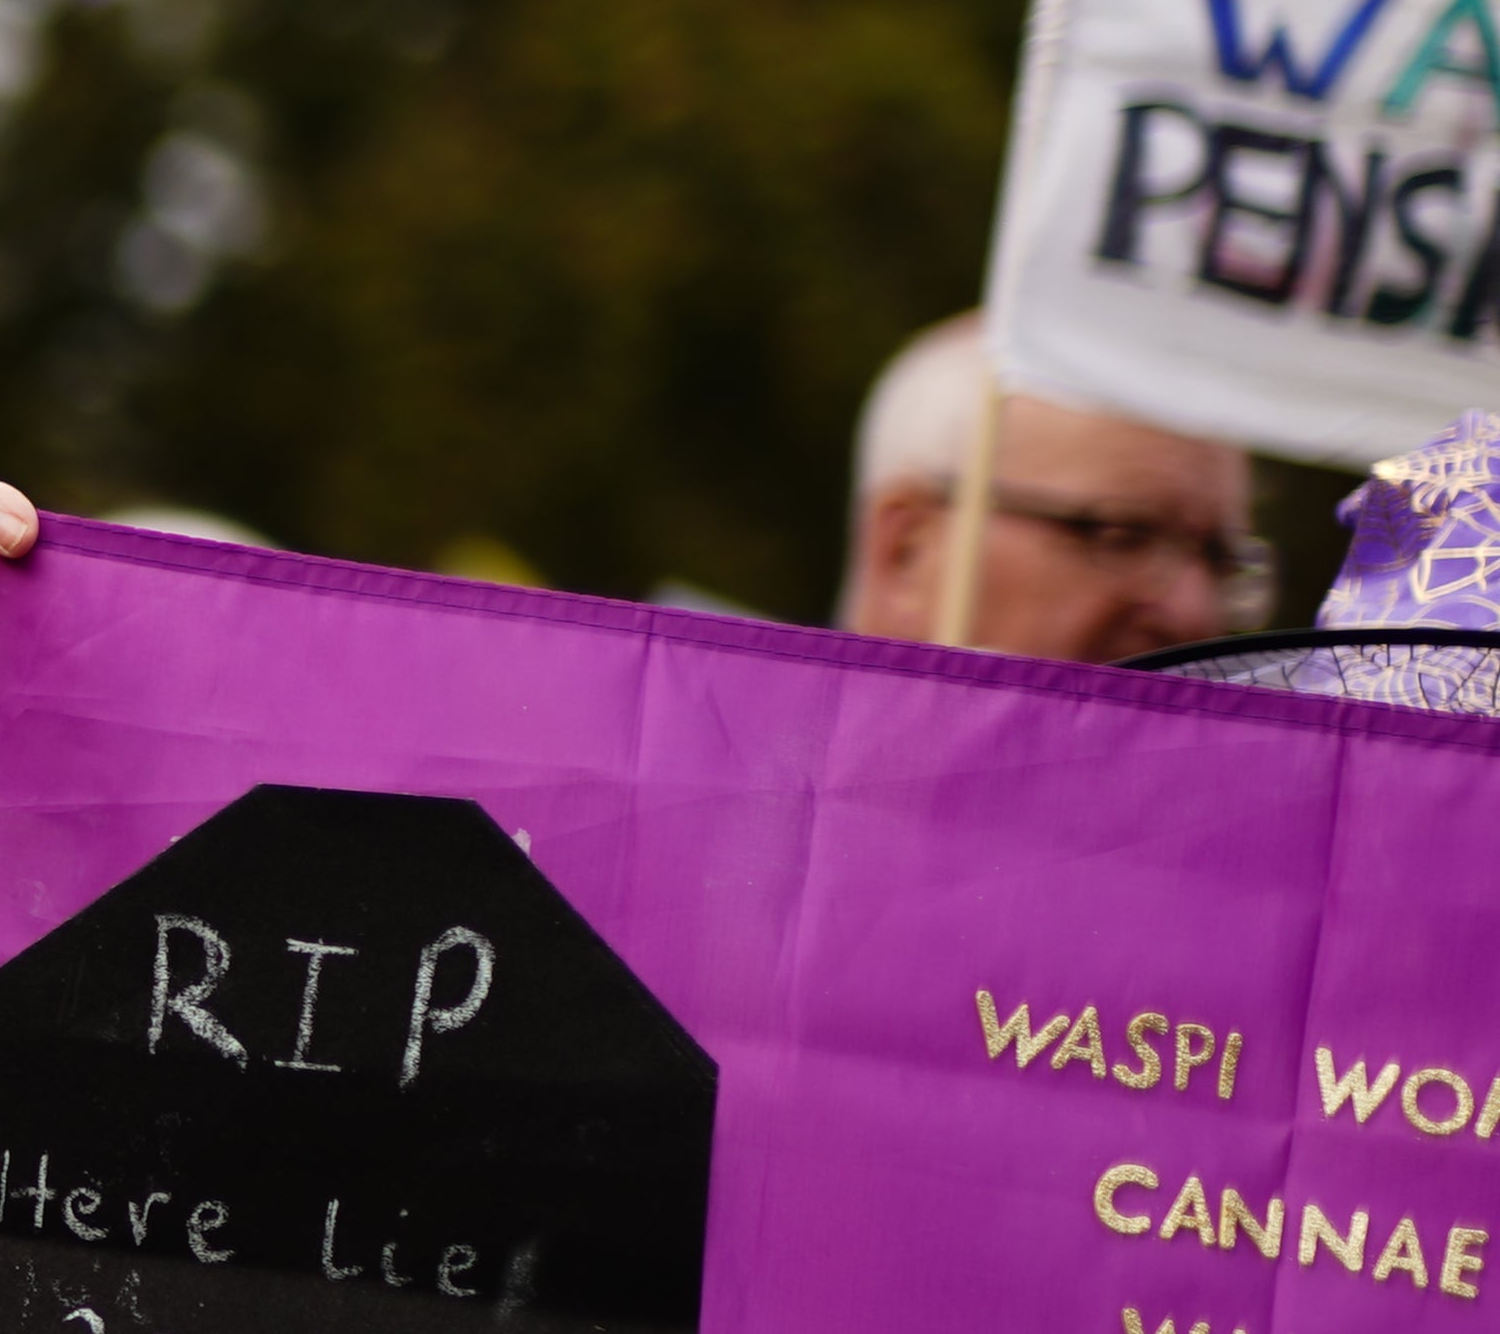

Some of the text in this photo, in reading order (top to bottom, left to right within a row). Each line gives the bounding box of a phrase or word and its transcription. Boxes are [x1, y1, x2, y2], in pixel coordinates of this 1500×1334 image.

[147, 913, 496, 1093] RIP
[974, 989, 1500, 1139] WASPI WO
[1094, 1163, 1489, 1300] CANNAE
